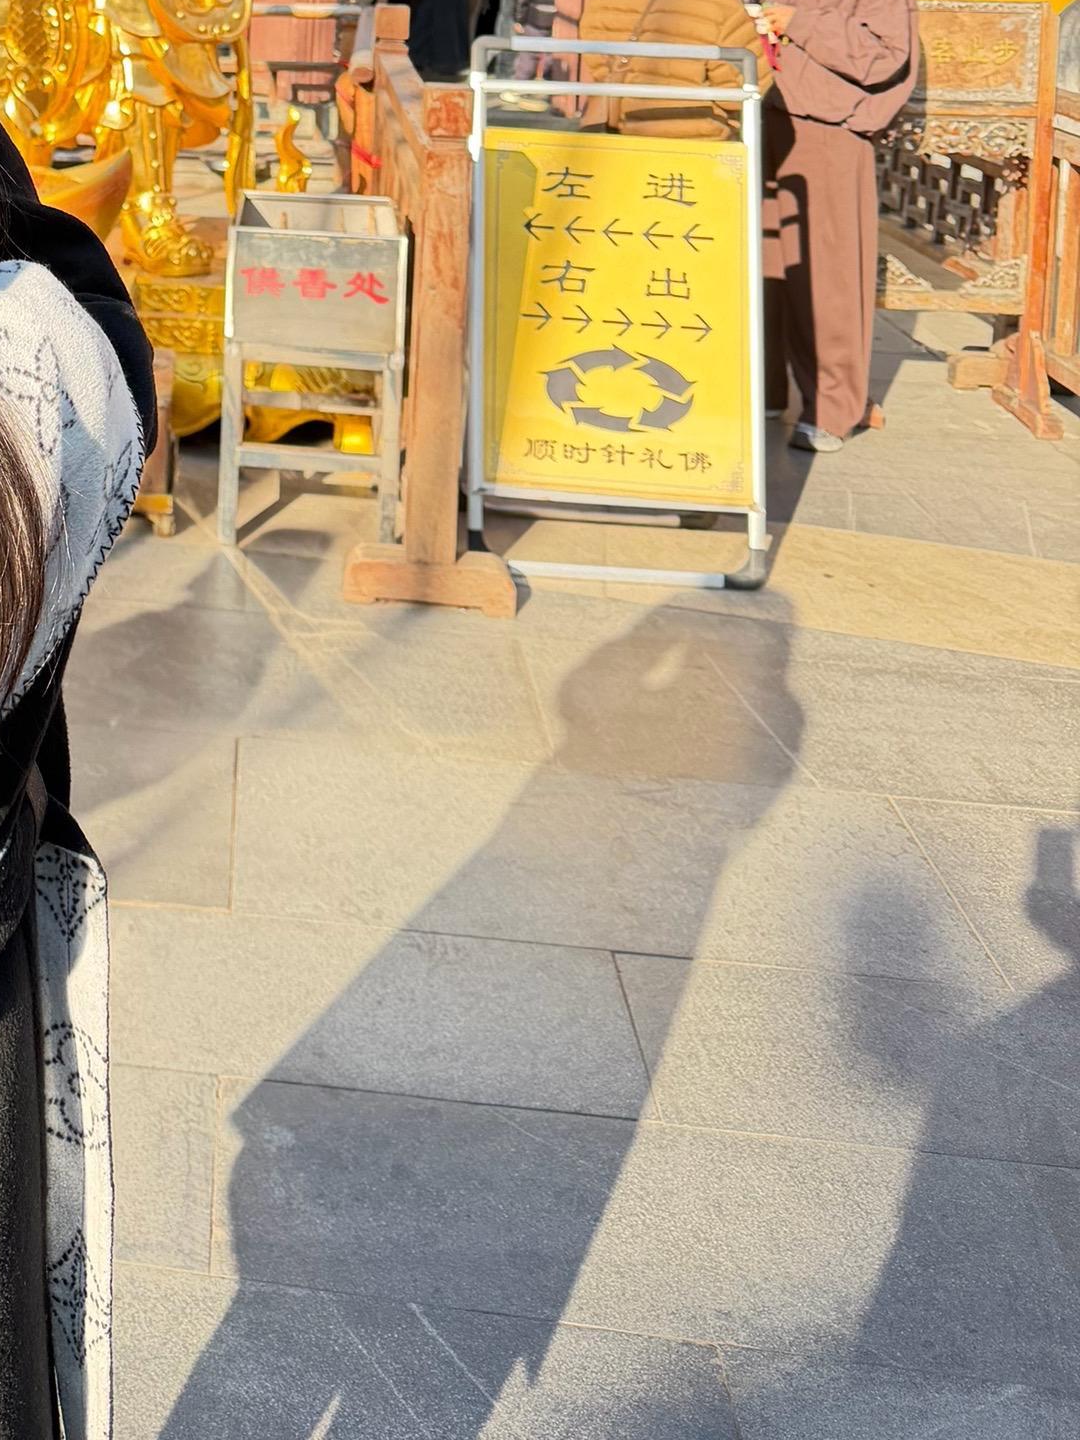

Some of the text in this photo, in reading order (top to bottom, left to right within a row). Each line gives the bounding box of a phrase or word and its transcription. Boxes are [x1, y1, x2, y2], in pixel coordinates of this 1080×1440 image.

[542, 166, 697, 207] 左 进
[541, 260, 690, 300] 右 出
[524, 438, 712, 473] 顺时针礼佛
